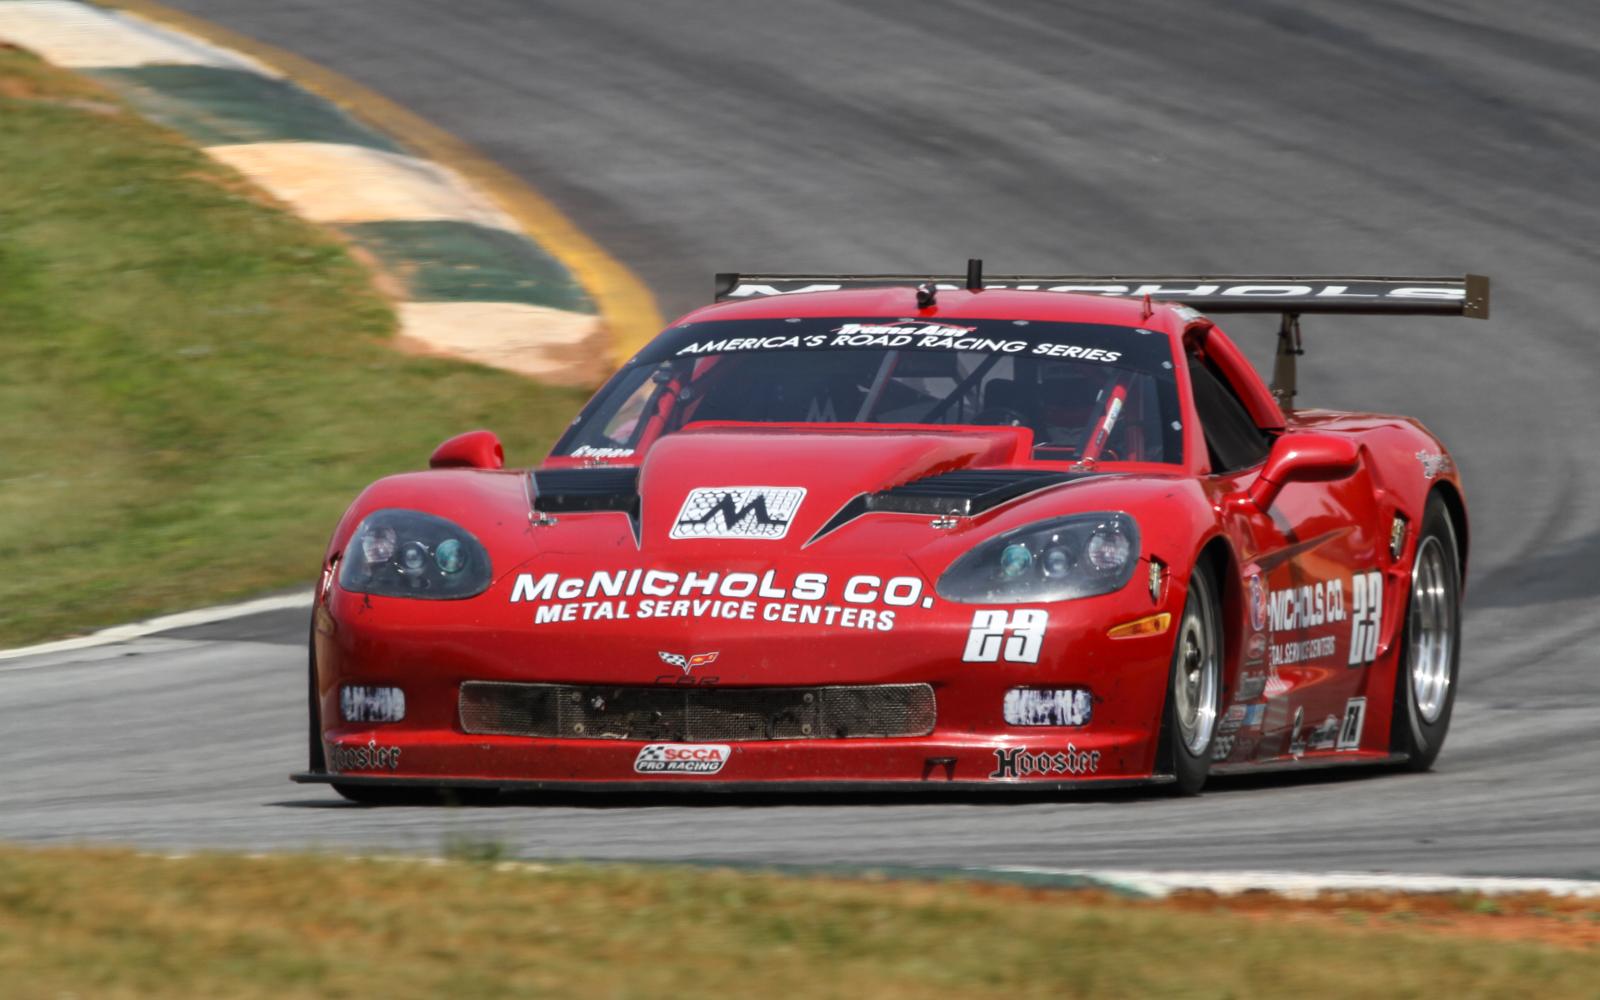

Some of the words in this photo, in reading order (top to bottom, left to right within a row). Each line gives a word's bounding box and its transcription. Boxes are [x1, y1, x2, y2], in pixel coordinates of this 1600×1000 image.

[675, 335, 827, 355] AMERICA'S
[831, 334, 912, 346] ROAD
[917, 336, 1028, 352] RACING
[1032, 343, 1122, 362] SERIES
[509, 568, 828, 602] McNICHOLS
[843, 575, 934, 608] CO.
[1267, 582, 1324, 632] NICHOLS
[1326, 578, 1346, 623] CO.
[534, 600, 630, 624] METAL
[636, 599, 757, 620] SERVICE
[763, 601, 896, 631] CENTERS
[1348, 570, 1382, 666] 23
[961, 608, 1048, 664] 23
[638, 761, 665, 770] PRO
[667, 761, 719, 771] RACING
[664, 748, 722, 762] SCCA
[988, 743, 1101, 780] Hoosier
